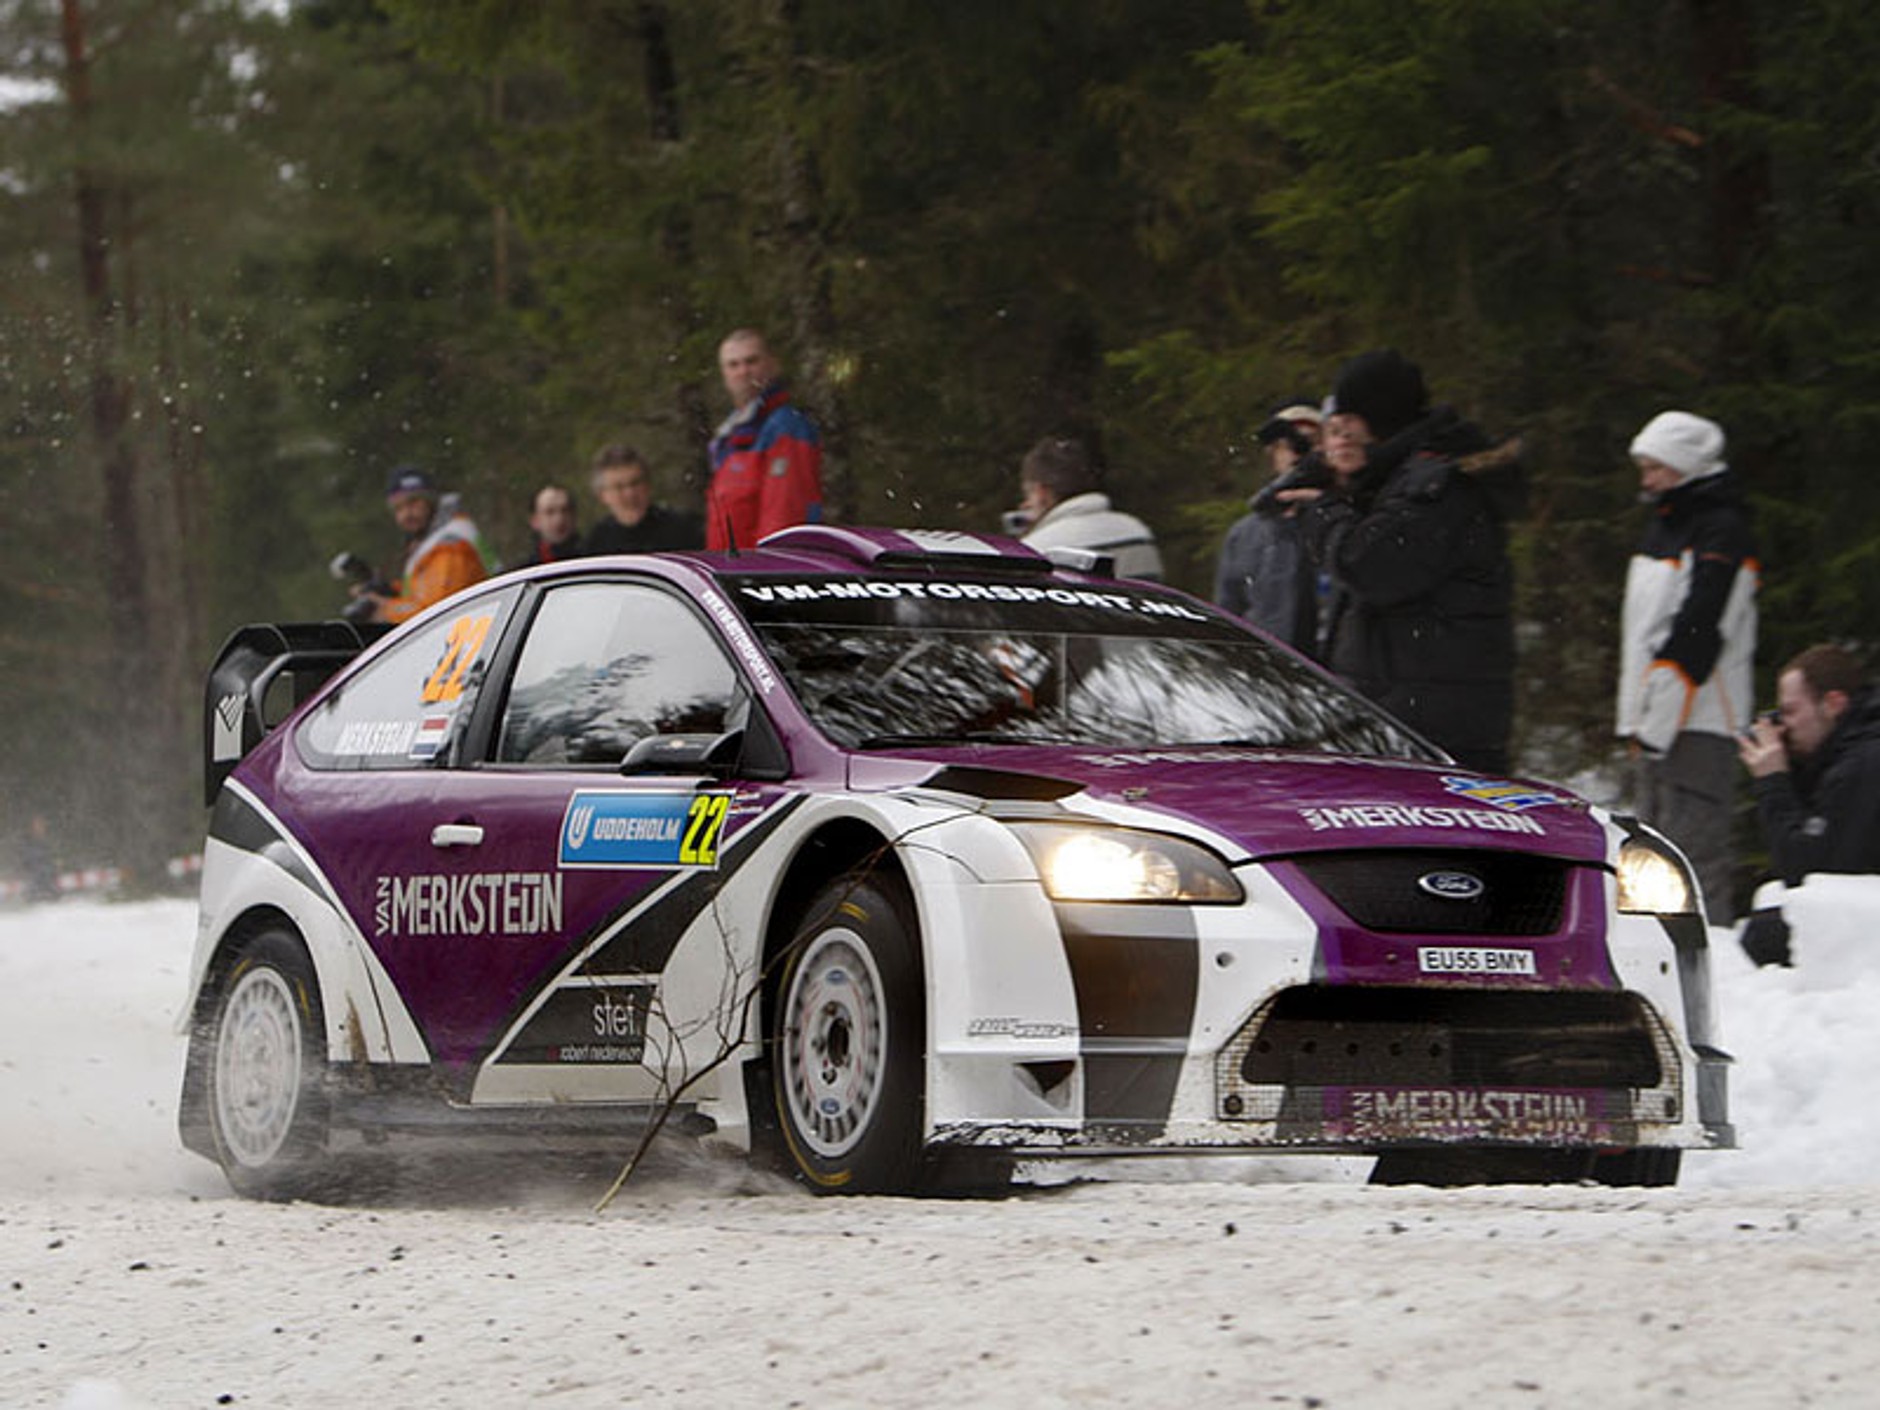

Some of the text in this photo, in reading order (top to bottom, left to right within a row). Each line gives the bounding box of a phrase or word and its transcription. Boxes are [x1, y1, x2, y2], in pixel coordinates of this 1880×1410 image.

[740, 583, 1208, 622] VM-MOTORSPORT.NL
[421, 616, 492, 703] 22
[593, 817, 681, 841] UDDEHOLM
[679, 795, 730, 864] 22
[375, 872, 564, 937] VAN MERKSTEIJN
[1484, 951, 1528, 970] BMY
